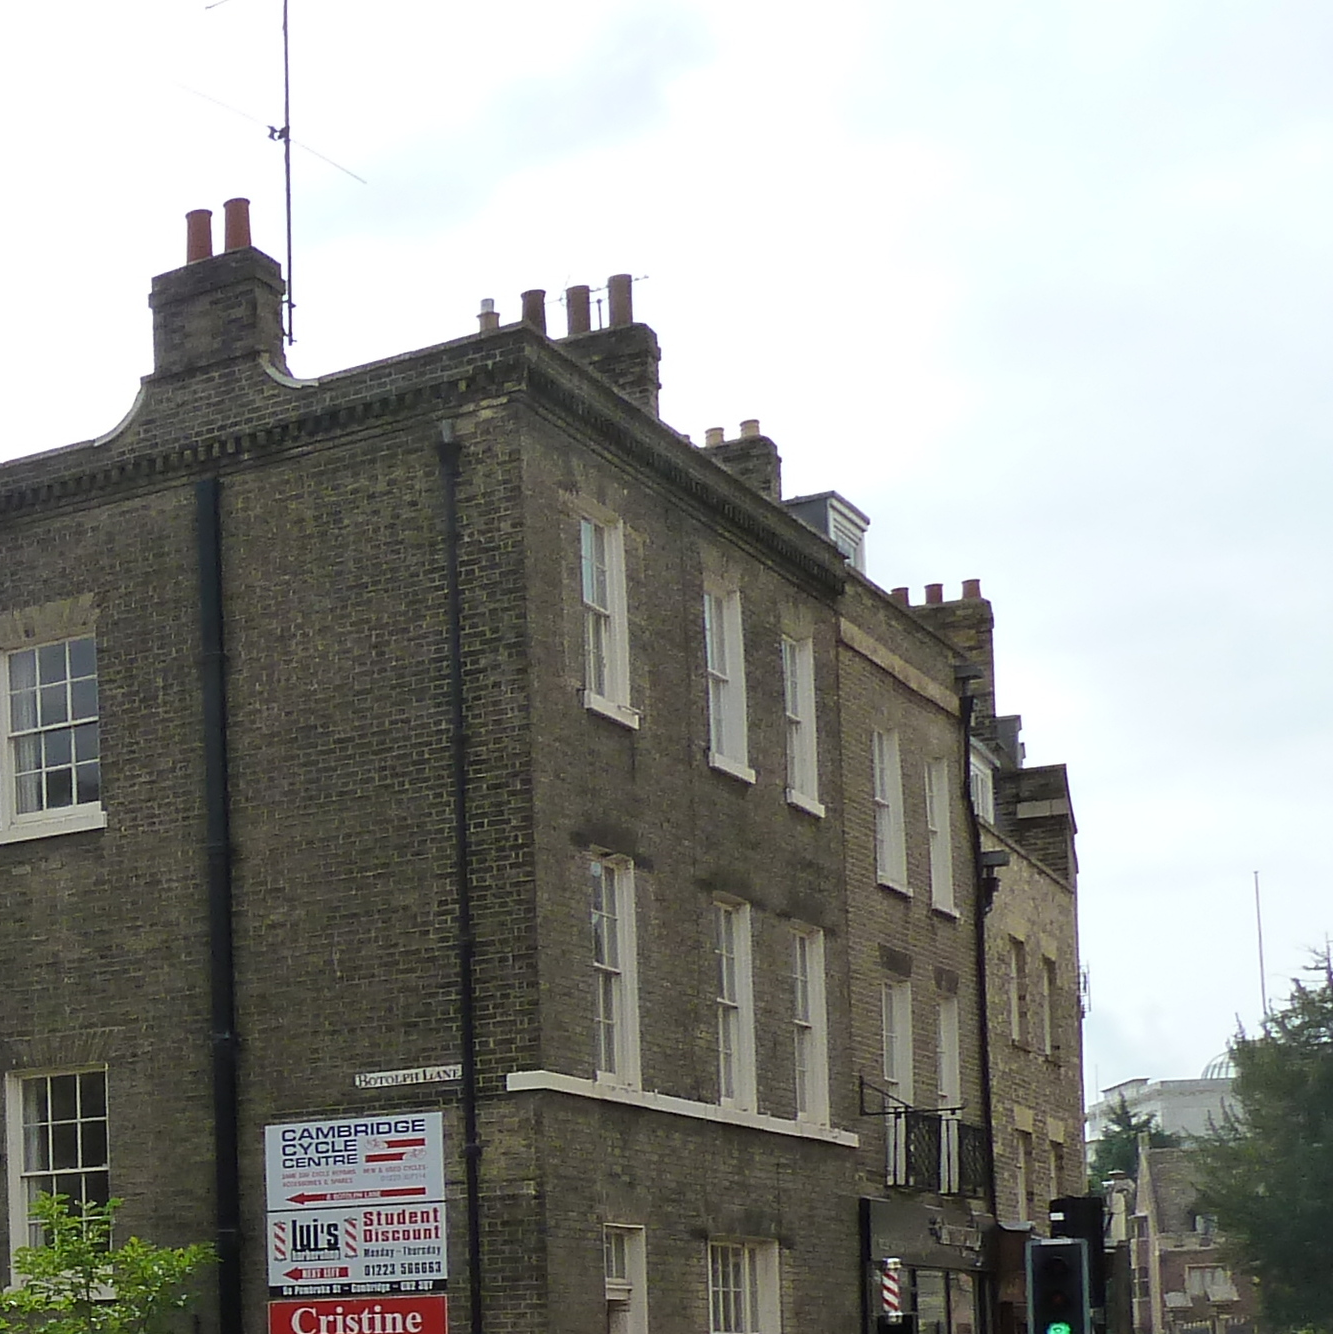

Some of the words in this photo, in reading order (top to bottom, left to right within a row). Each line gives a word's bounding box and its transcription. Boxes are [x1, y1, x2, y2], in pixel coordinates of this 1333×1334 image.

[359, 1072, 419, 1086] BOTOLPH
[422, 1068, 459, 1080] LANE
[282, 1119, 425, 1142] CAMBRIDGE
[282, 1139, 357, 1157] CYCLE
[282, 1154, 358, 1169] CENTRE
[363, 1207, 440, 1227] Student
[291, 1219, 339, 1251] lui's
[363, 1225, 441, 1243] Discount
[363, 1247, 395, 1259] Monday
[402, 1245, 441, 1256] Thursday
[364, 1263, 396, 1276] 01223
[294, 1285, 331, 1295] Pembroke
[351, 1283, 390, 1293] Cambridge
